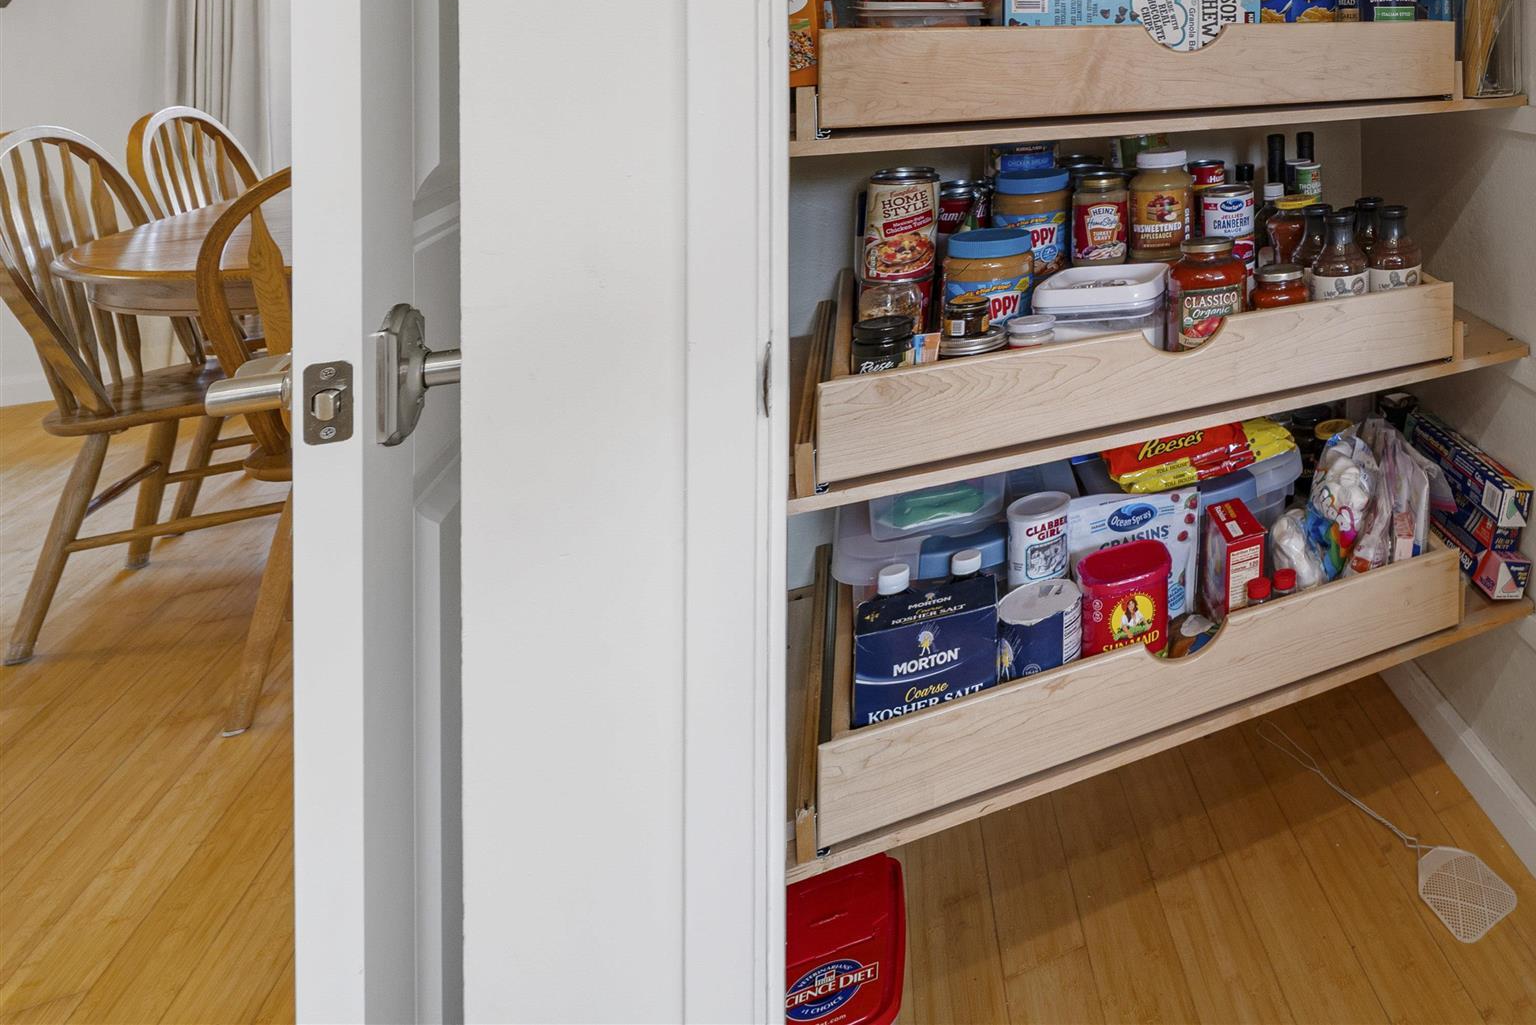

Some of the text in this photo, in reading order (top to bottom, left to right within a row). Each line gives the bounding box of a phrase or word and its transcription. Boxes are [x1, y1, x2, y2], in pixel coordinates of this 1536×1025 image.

[1141, 6, 1153, 32] CHIPS
[1158, 3, 1169, 26] REAL
[1169, 12, 1179, 31] WITH
[1188, 7, 1197, 39] Granola
[881, 190, 928, 209] HOME
[882, 199, 929, 218] STYLE
[1092, 207, 1114, 216] HEINZ
[1221, 212, 1243, 220] JELLIED
[886, 224, 913, 234] Chicken
[1133, 222, 1182, 233] UNSWEETENED
[1213, 216, 1251, 230] CRANBERRY
[1030, 226, 1056, 248] PPY
[1140, 232, 1173, 240] APPLESAUCE
[1184, 291, 1238, 309] CLASSICO
[1191, 305, 1231, 320] Organic
[1170, 462, 1188, 472] HOUSE
[1110, 509, 1151, 527] Ocean Spray
[1038, 528, 1062, 541] GIRL
[908, 596, 952, 610] MORTON
[891, 603, 967, 625] KOSHER SALT
[893, 647, 960, 677] MORTON
[905, 681, 949, 703] Coarse
[868, 697, 940, 725] KOSHER
[786, 981, 836, 1009] CIENCE
[838, 967, 874, 990] DIET
[810, 995, 844, 1015] CHOICE
